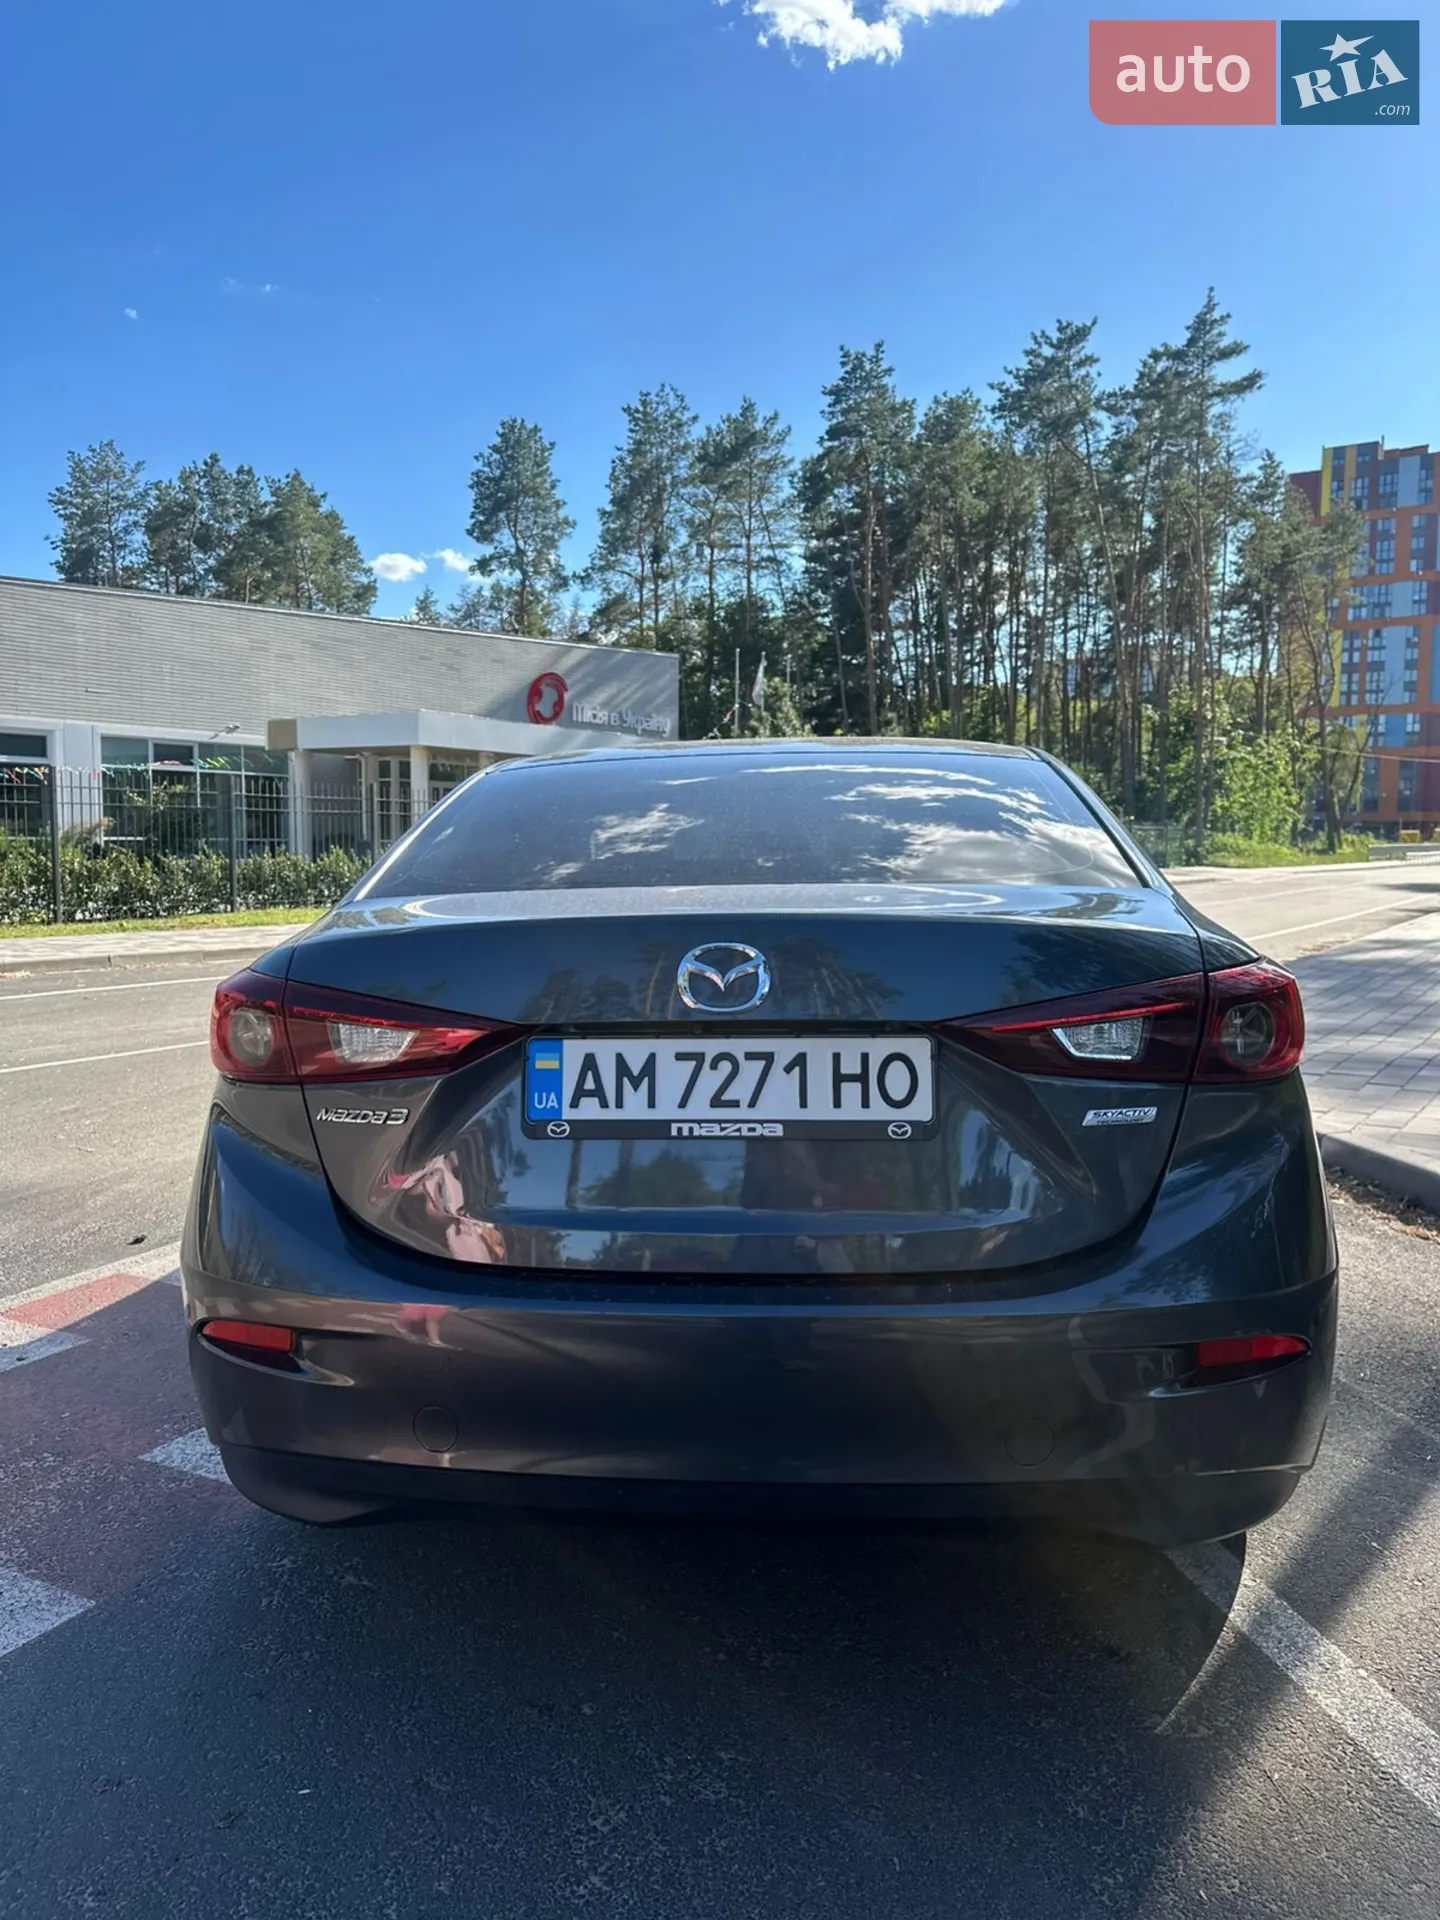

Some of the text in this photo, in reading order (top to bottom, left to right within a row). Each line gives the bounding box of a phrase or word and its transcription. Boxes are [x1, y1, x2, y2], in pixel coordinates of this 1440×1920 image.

[569, 1051, 919, 1109] AM 7271 HO
[534, 1092, 559, 1109] UA
[1092, 1109, 1152, 1118] SKYACTIV
